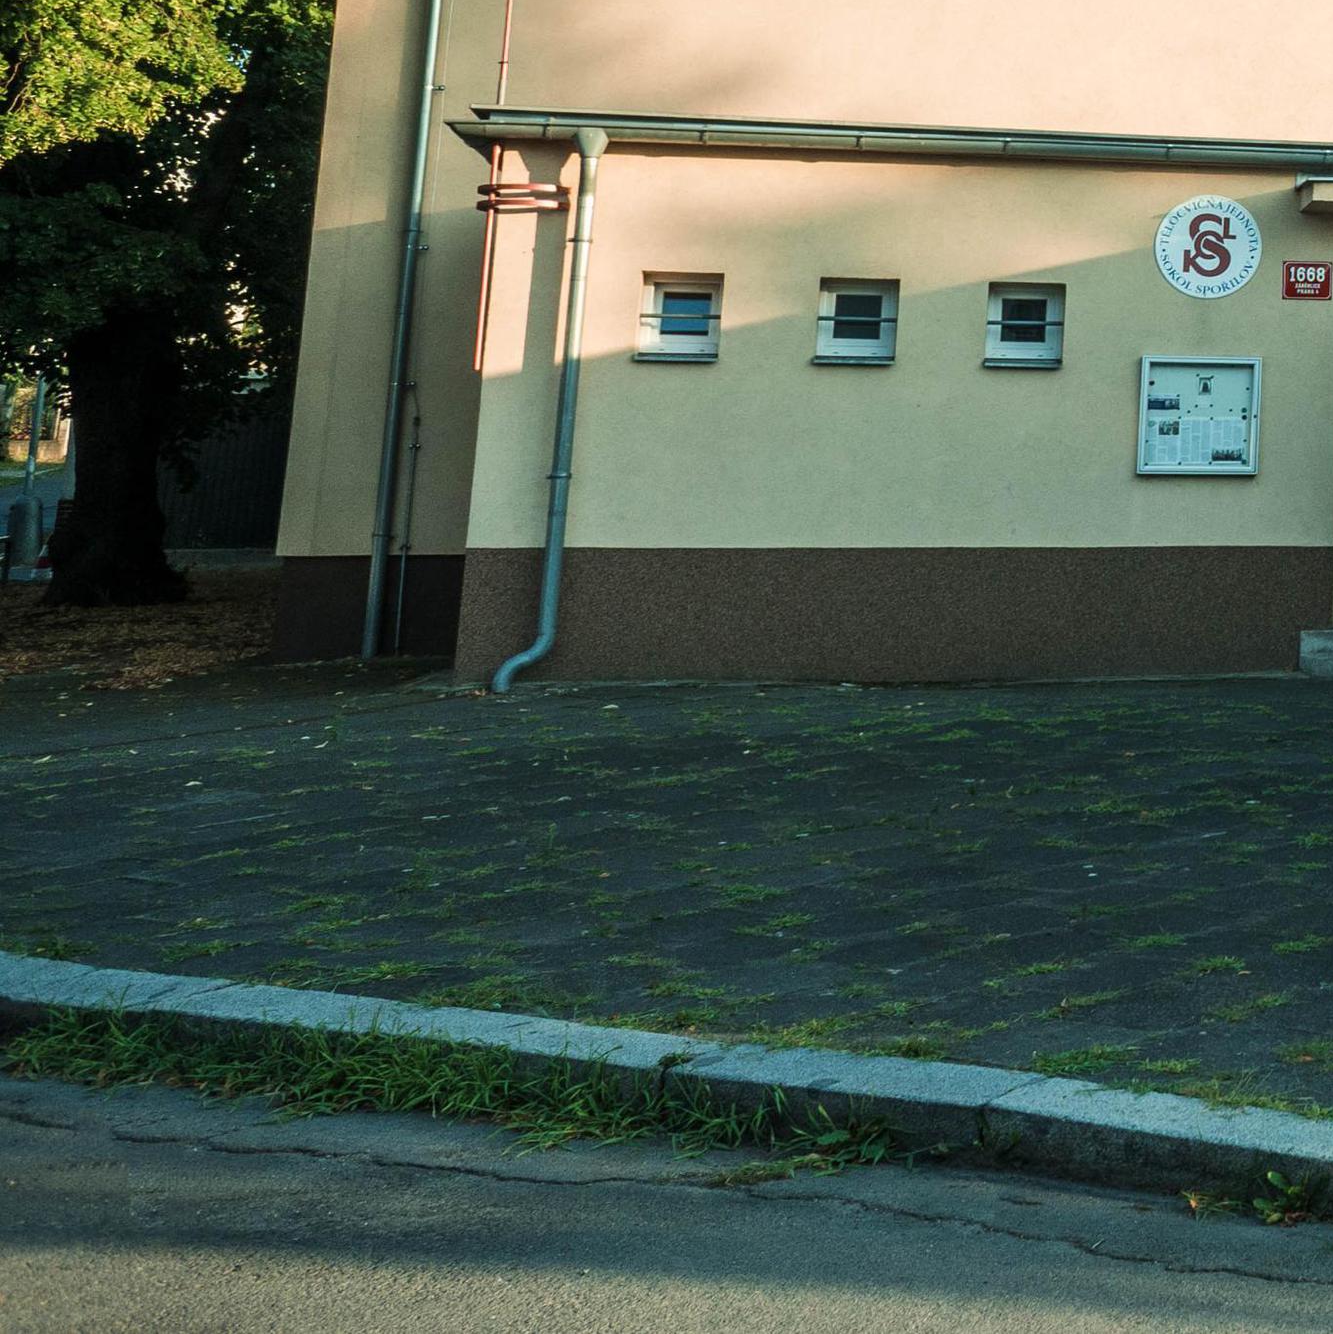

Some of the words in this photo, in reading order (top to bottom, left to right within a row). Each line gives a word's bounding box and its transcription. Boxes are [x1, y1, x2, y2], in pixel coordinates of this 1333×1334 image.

[1225, 204, 1259, 253] JEDNOTA
[1160, 253, 1193, 291] SOKOL
[1289, 266, 1325, 283] 1668
